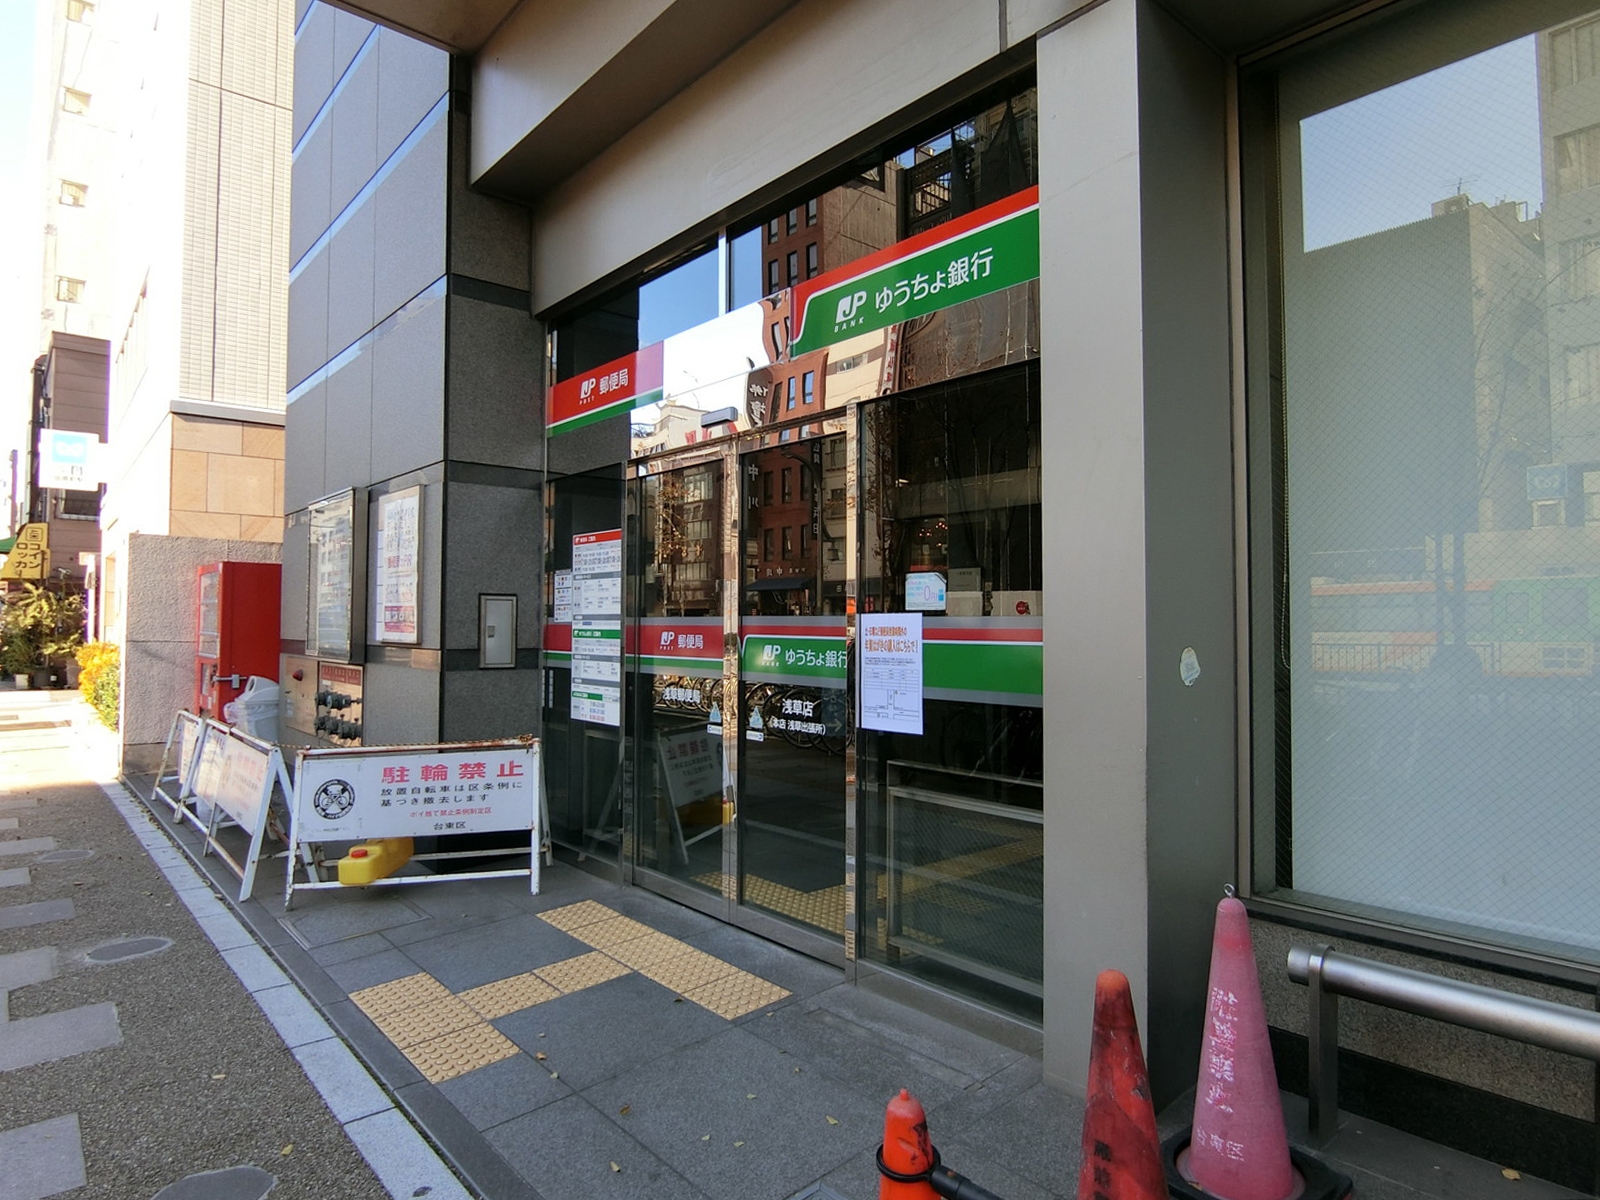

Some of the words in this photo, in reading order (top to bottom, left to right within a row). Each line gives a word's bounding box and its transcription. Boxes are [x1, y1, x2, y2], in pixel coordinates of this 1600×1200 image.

[875, 246, 994, 314] ゆうちょ銀行
[834, 316, 865, 333] BANK
[599, 368, 629, 395] 郵便局
[29, 543, 41, 569] コイン
[677, 633, 704, 650] 郵便局
[784, 648, 847, 669] ゆうちょ銀行
[662, 686, 701, 705] 浅草郵便局
[781, 698, 814, 718] 浅草店
[381, 759, 525, 784] 駐輪禁止
[380, 780, 524, 797] 放置自転車は区条例に
[380, 793, 491, 807] 基つき撤去します
[410, 806, 493, 818] ポイ捨て禁止条例制定区
[433, 820, 467, 831] 台東区
